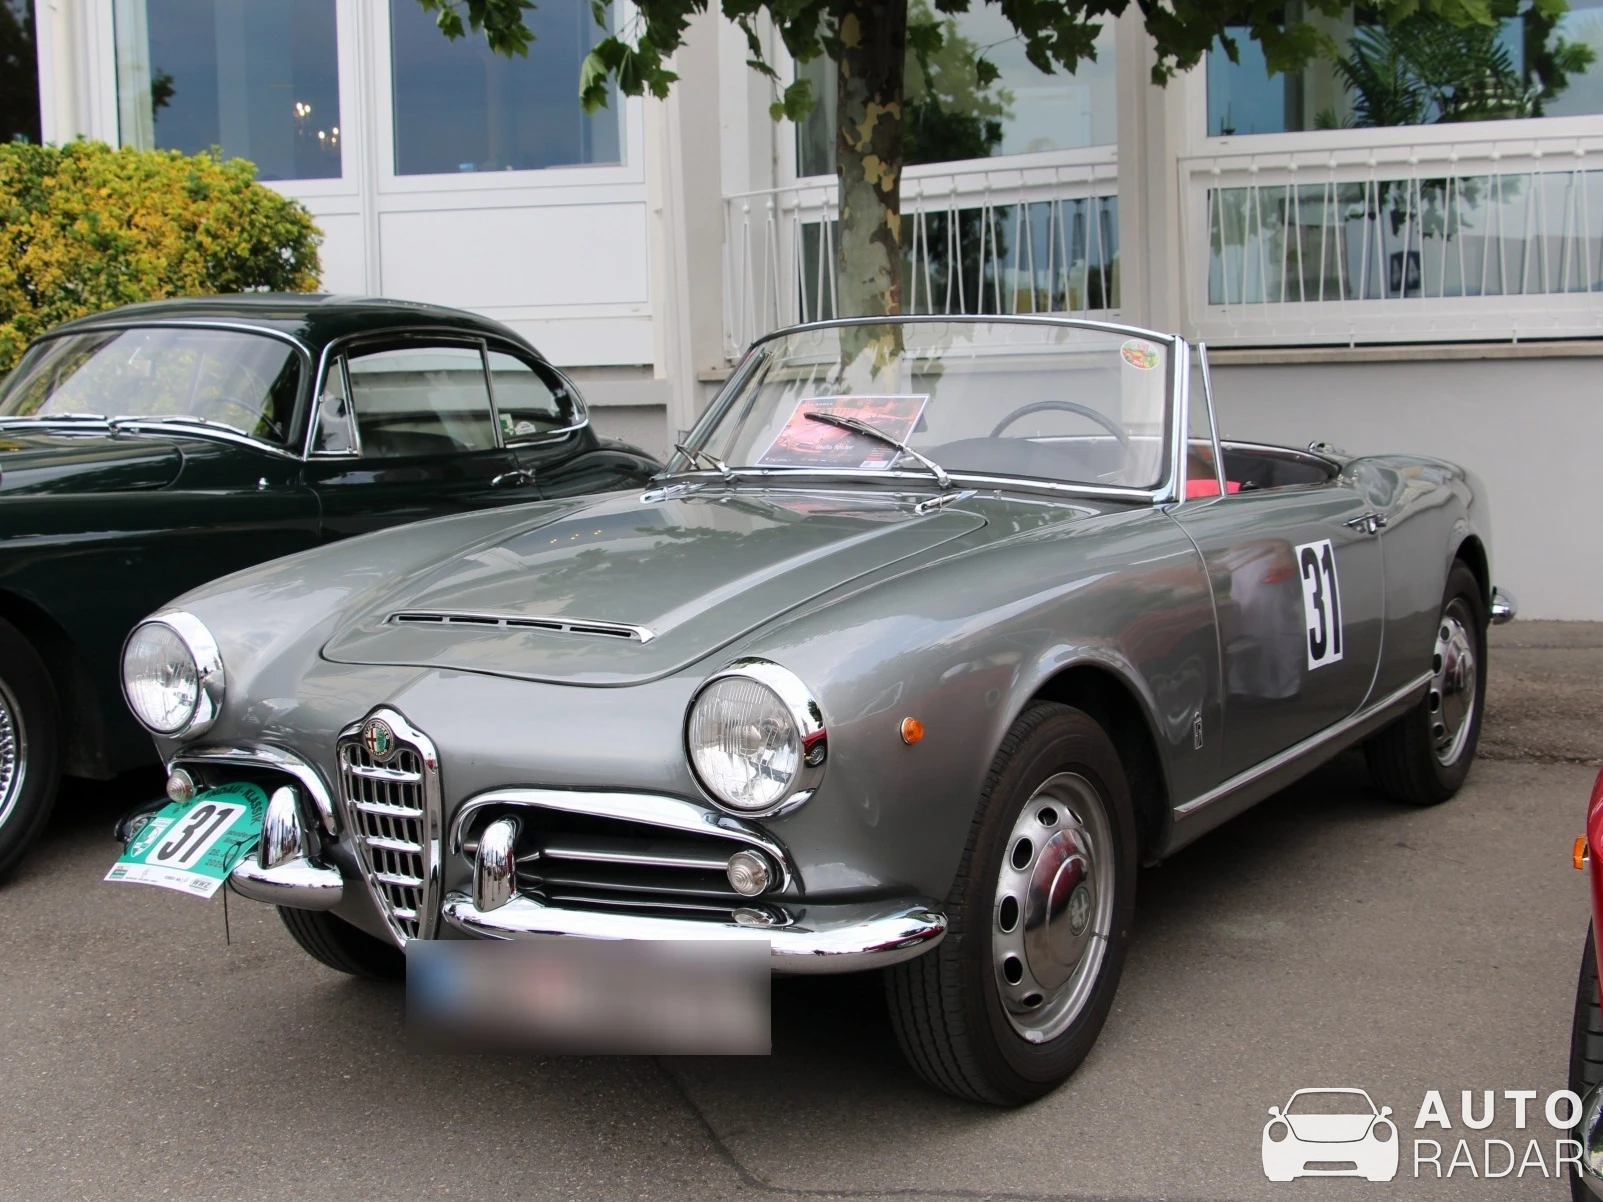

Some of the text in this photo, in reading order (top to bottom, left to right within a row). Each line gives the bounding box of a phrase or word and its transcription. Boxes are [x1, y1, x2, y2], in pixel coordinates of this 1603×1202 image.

[1300, 544, 1340, 661] 31
[157, 804, 235, 863] 31
[192, 878, 212, 889] WWZ
